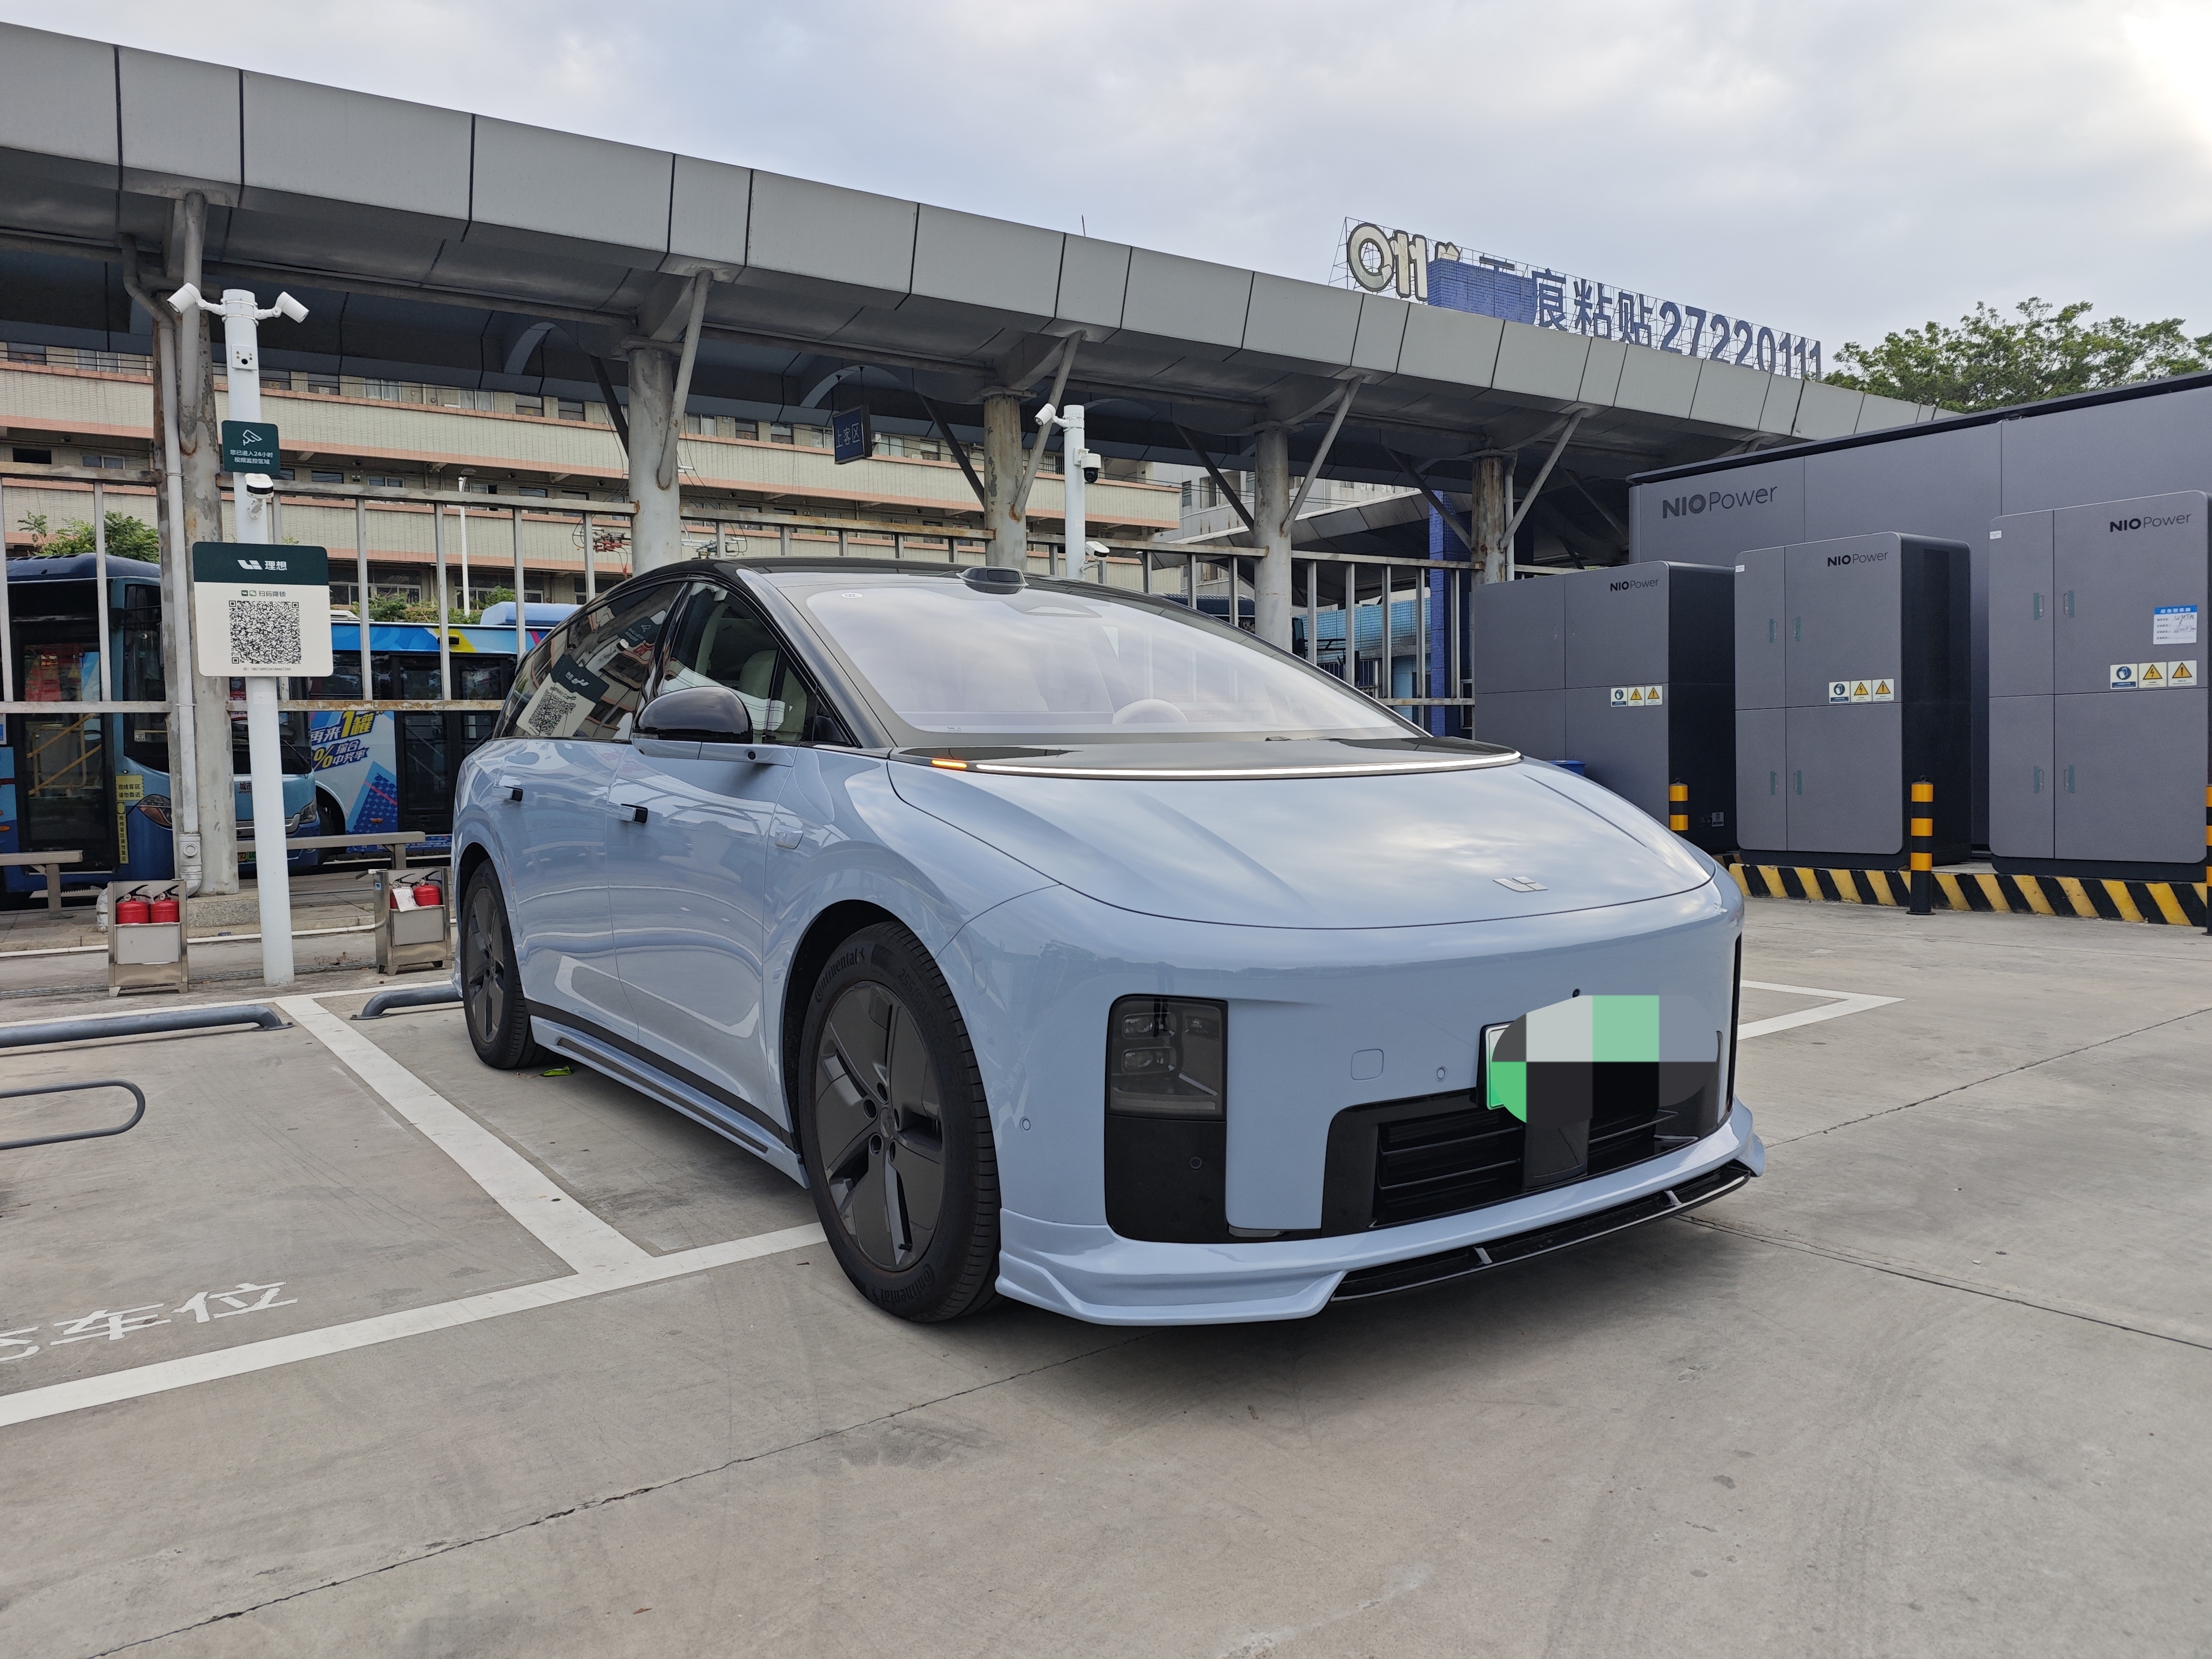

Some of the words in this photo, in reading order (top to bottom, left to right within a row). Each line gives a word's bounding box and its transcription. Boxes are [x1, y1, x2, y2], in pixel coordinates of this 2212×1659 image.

[835, 422, 860, 448] 上客区
[230, 449, 273, 458] 您已进入24小时
[264, 560, 288, 571] 理想
[335, 740, 359, 755] 综合
[332, 749, 367, 765] 中奖率
[814, 948, 858, 1003] Continental
[880, 1263, 936, 1306] Continental
